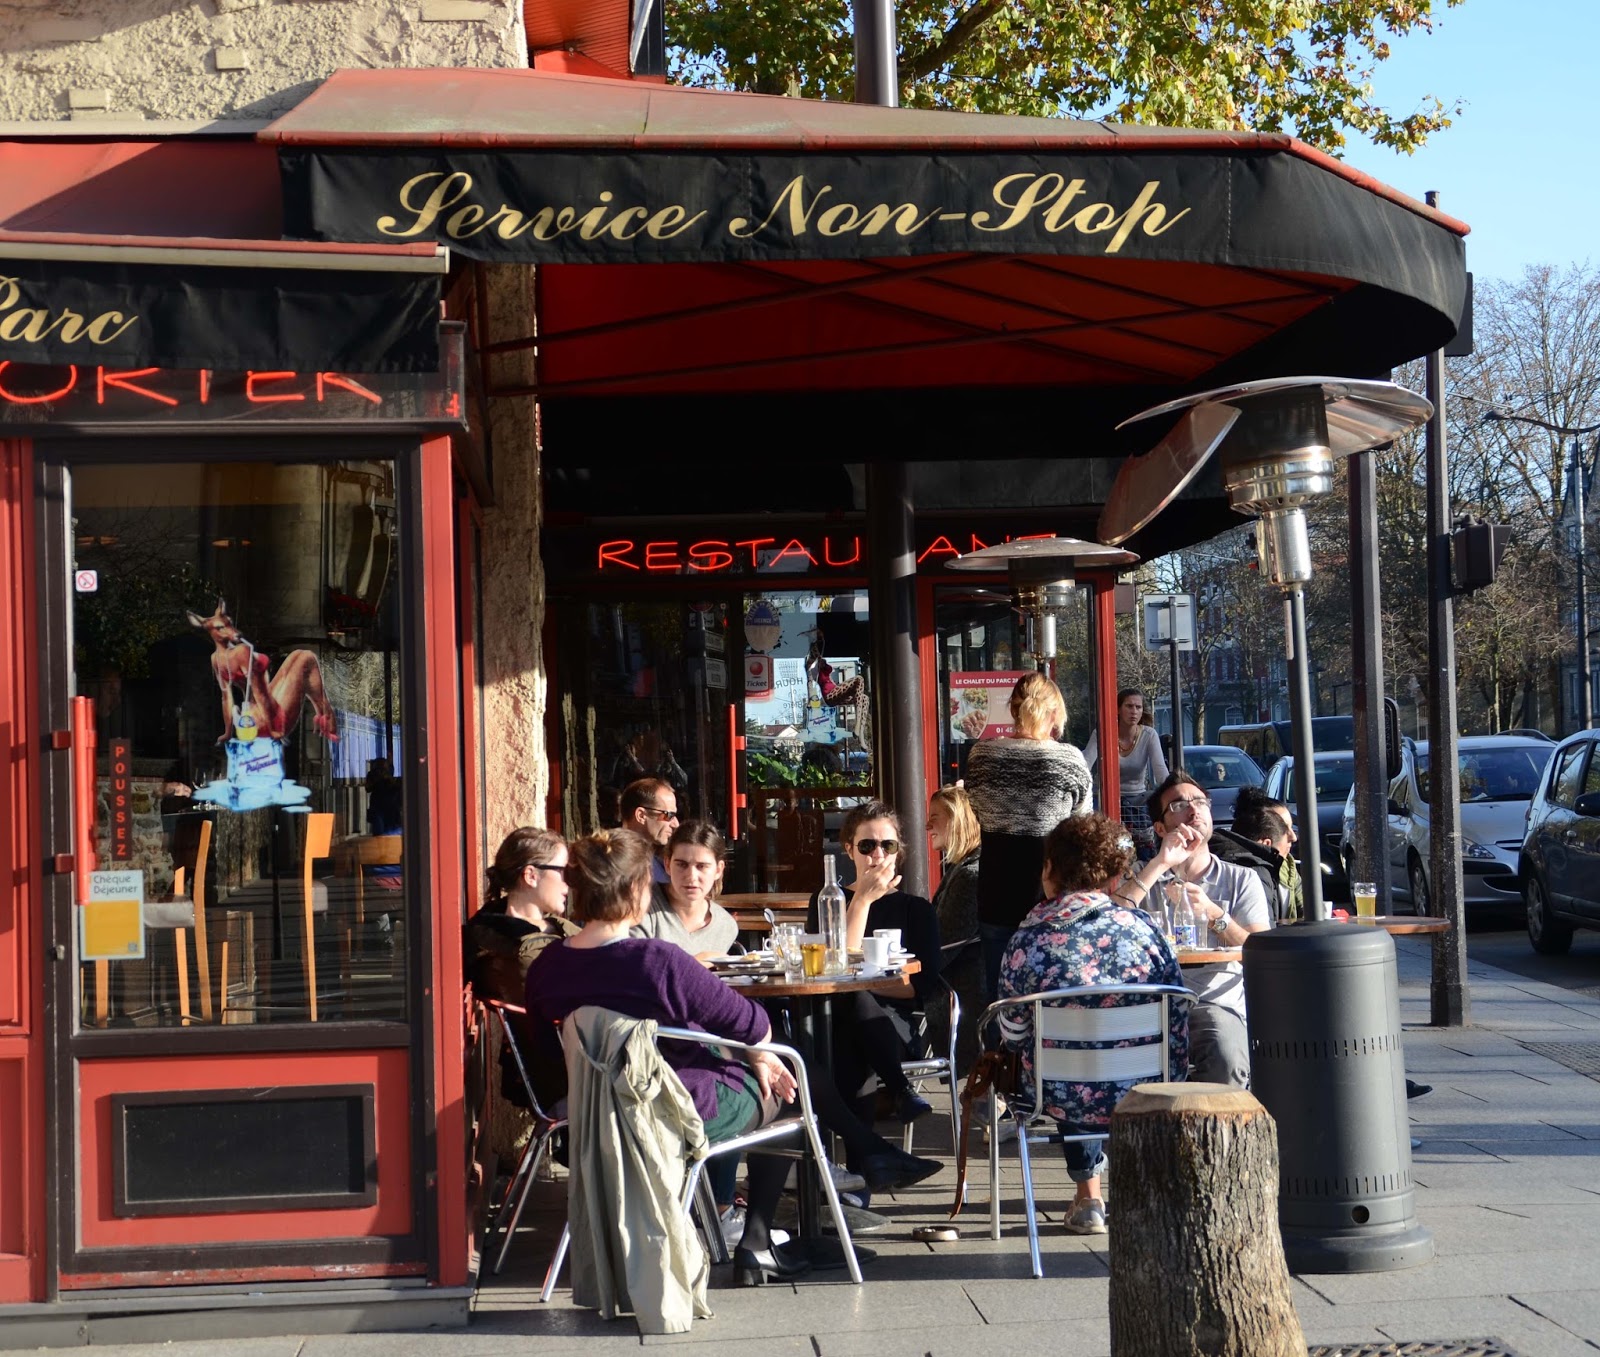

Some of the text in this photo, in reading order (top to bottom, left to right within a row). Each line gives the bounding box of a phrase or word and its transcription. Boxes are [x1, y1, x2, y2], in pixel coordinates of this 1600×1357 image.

[376, 171, 1191, 254] Service Non-Stop
[597, 532, 1057, 570] RESTAUAN
[115, 746, 126, 856] POUSSEZ
[93, 875, 132, 884] Chèque
[93, 885, 138, 896] Déjeuner
